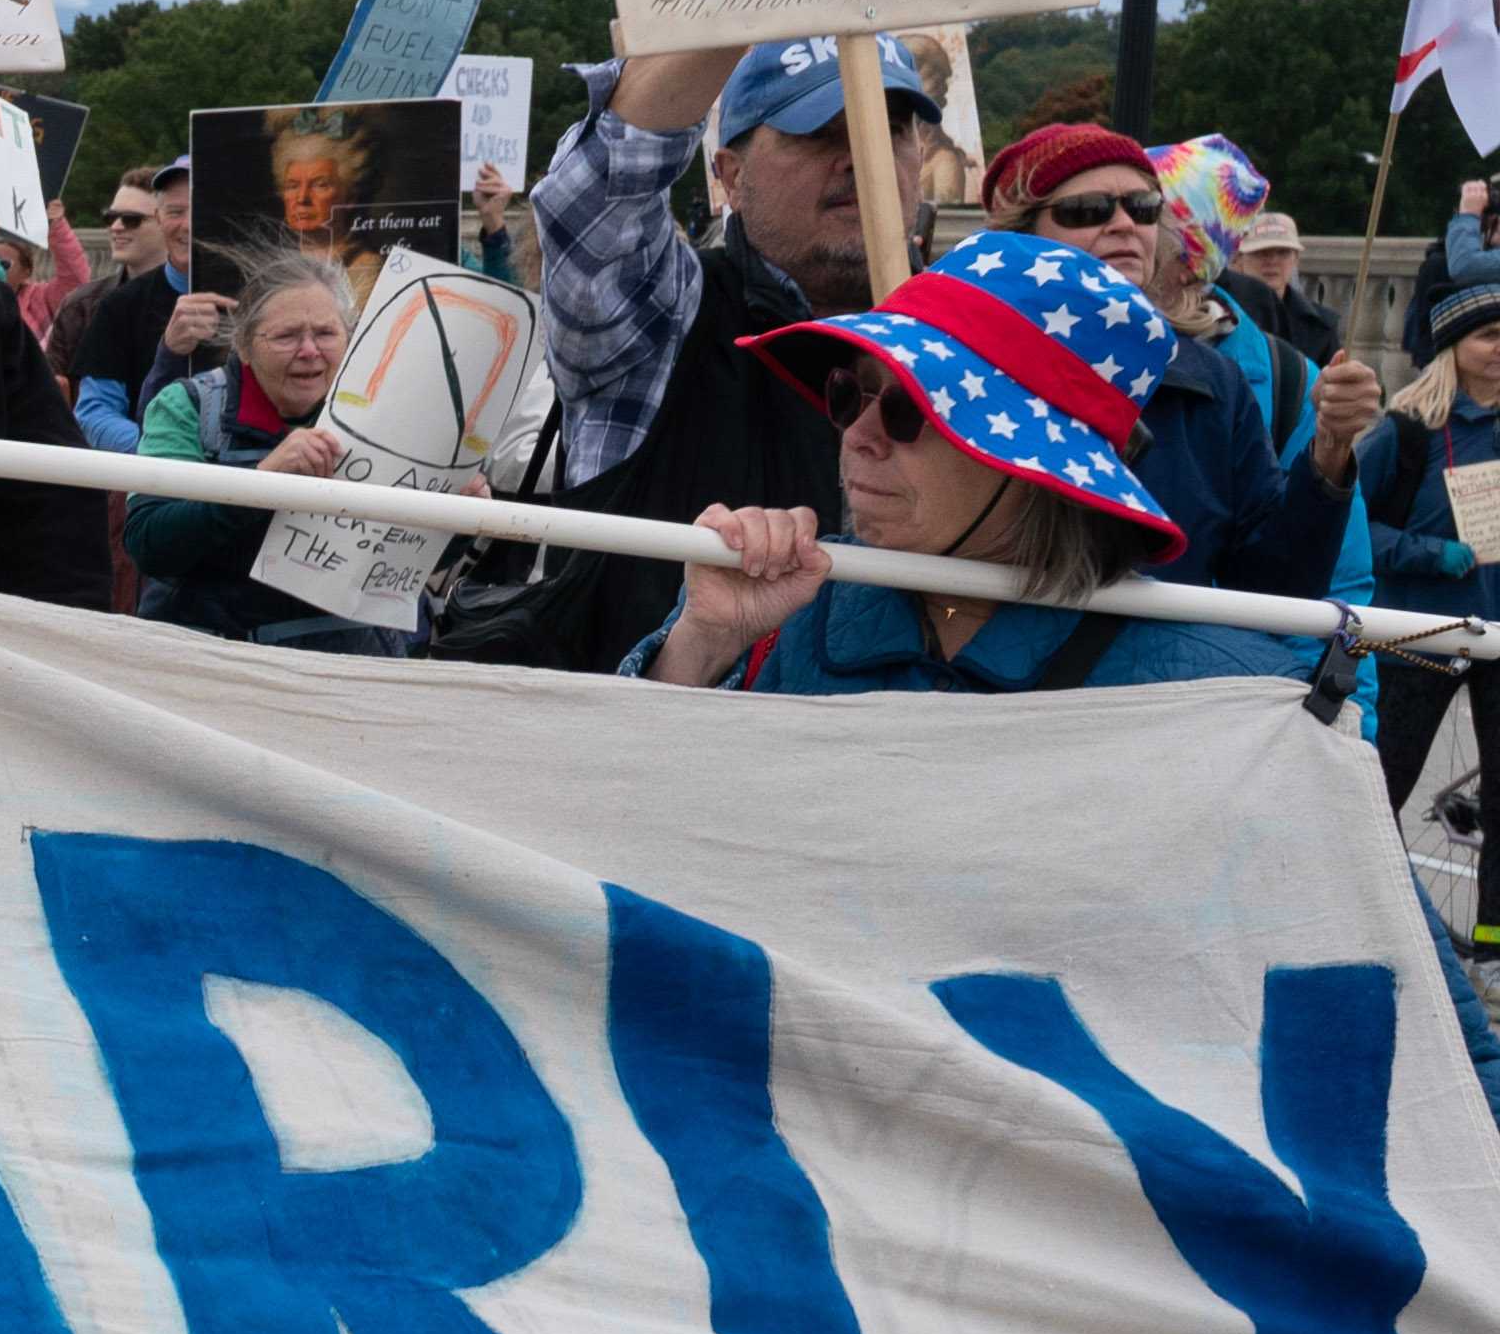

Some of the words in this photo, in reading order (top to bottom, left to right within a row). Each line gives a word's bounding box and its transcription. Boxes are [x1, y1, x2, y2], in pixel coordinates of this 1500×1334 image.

[363, 24, 437, 61] FUEL
[456, 67, 508, 98] CHECKS
[349, 216, 374, 232] Let
[380, 211, 414, 229] them
[418, 215, 442, 228] eat
[284, 524, 348, 571] THE
[361, 562, 422, 592] PEOPLE
